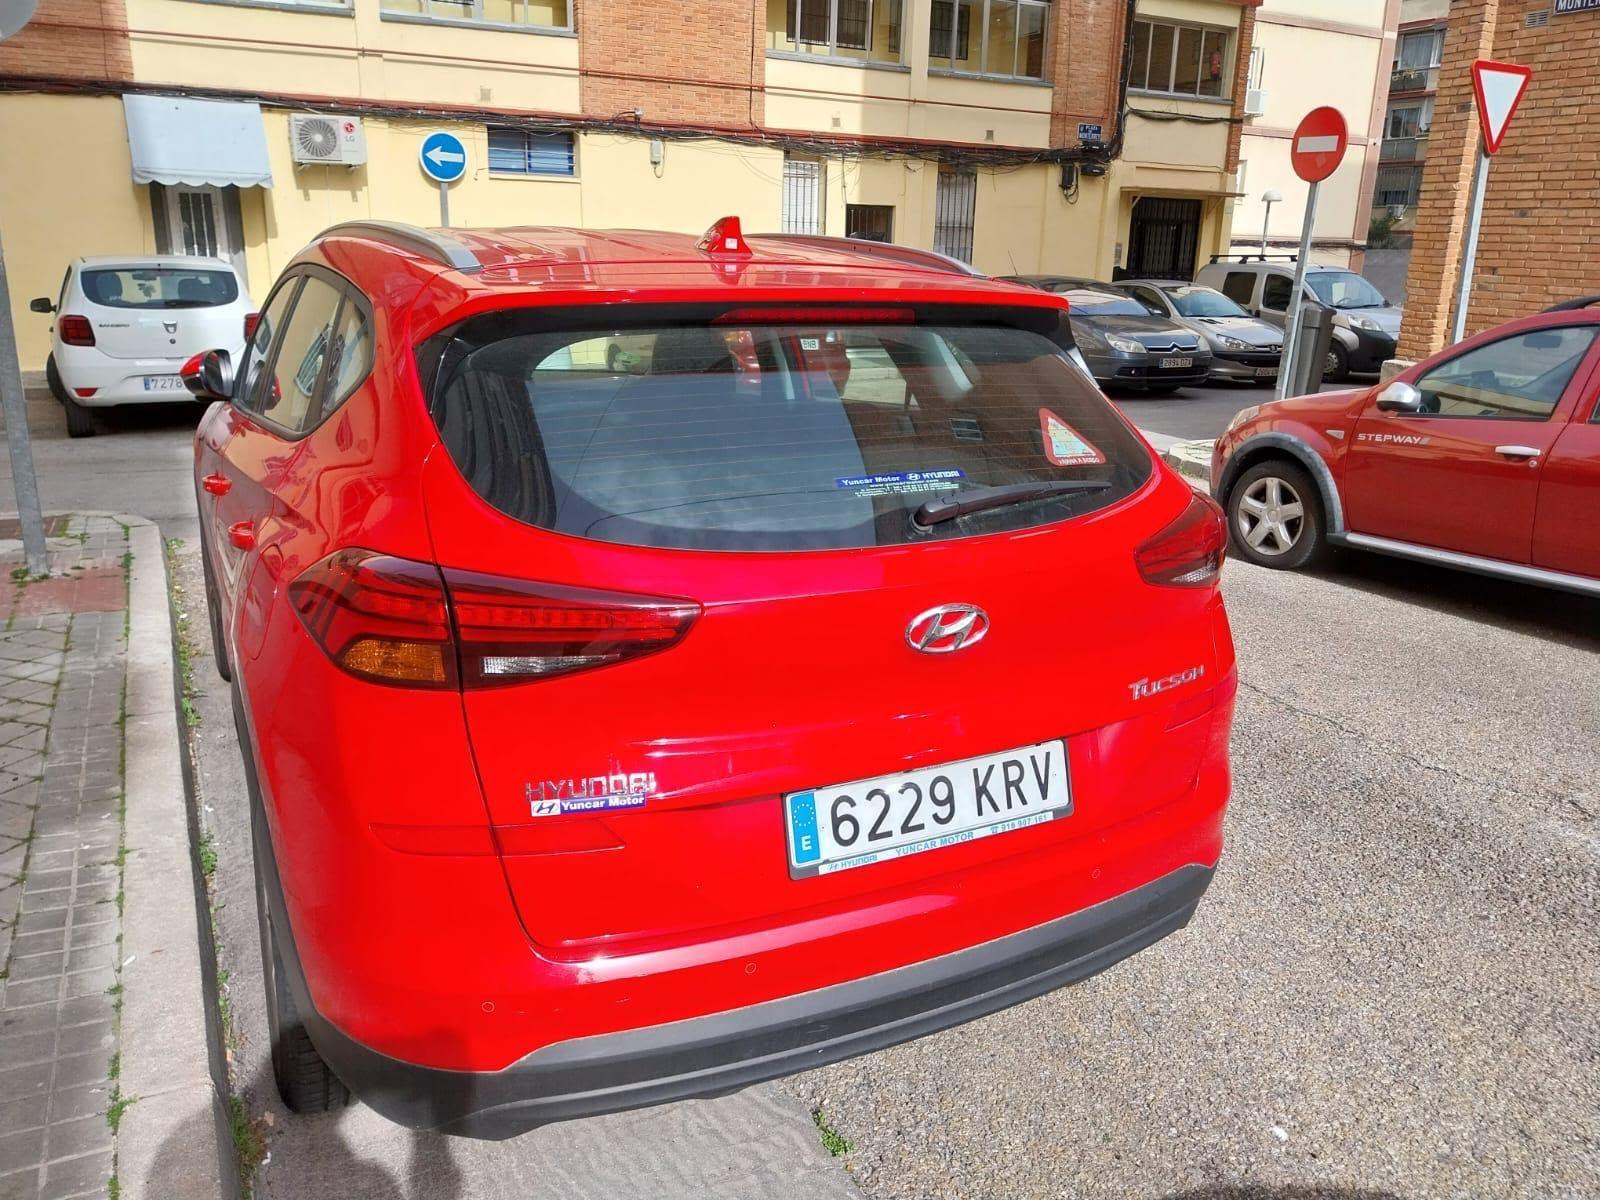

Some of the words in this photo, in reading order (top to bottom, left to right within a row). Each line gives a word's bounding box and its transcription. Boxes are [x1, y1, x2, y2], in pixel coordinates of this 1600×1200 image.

[1557, 0, 1600, 10] MONTE
[151, 378, 183, 390] 7278
[1357, 433, 1422, 445] STEPWAY
[841, 477, 874, 486] Yuncar
[874, 475, 901, 483] Motor
[921, 470, 961, 479] HYUNDAI
[525, 772, 657, 802] HYUNDAI
[561, 800, 606, 811] Yuncar
[608, 795, 645, 808] Motor
[830, 774, 957, 848] 6229
[972, 751, 1051, 817] KRV
[801, 835, 813, 852] E
[840, 854, 878, 868] HYUNDAI
[895, 840, 938, 857] YUNCAR
[939, 831, 975, 847] MOTOR
